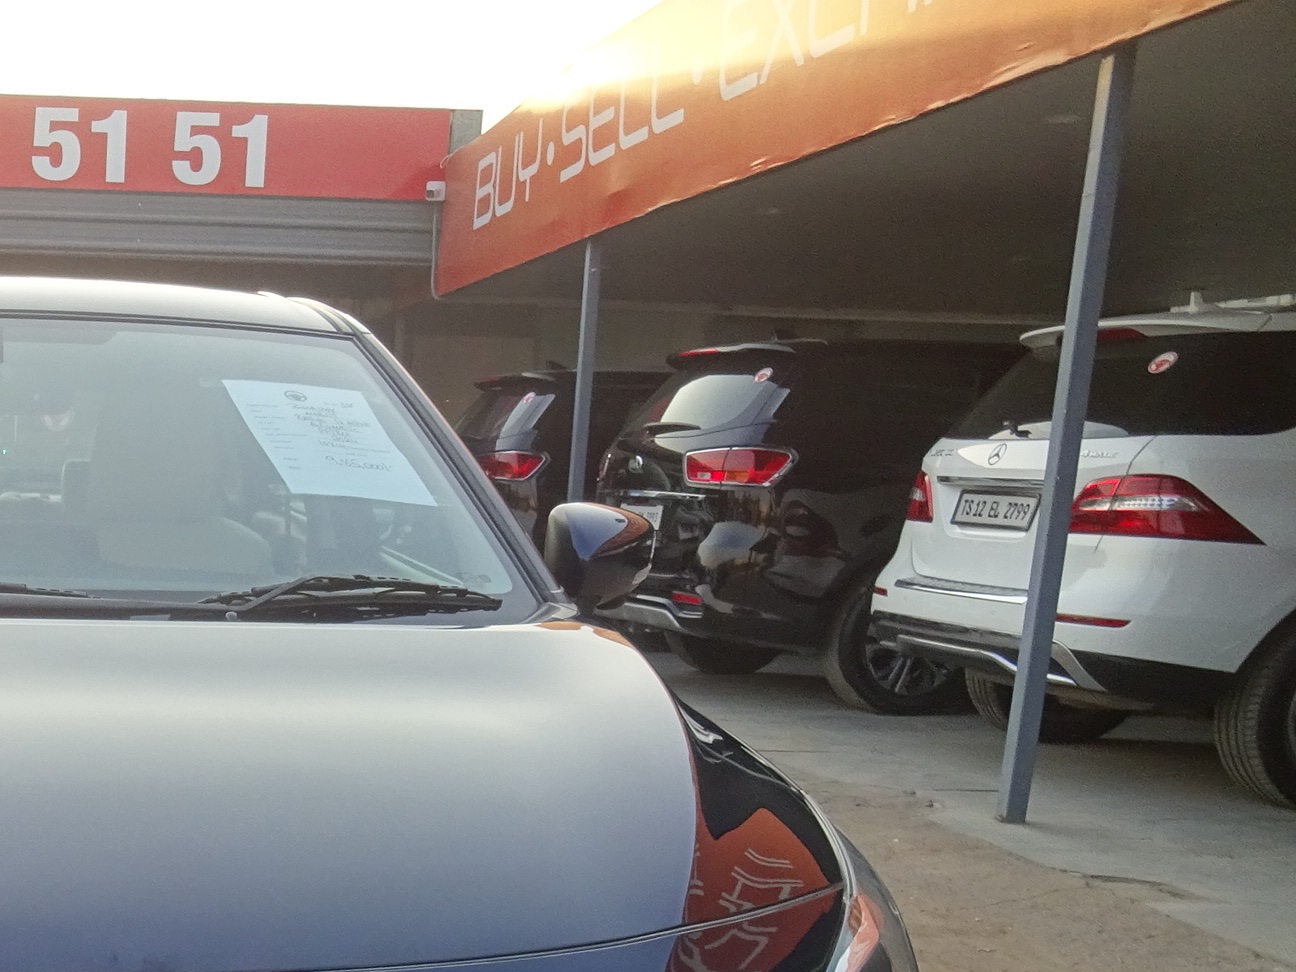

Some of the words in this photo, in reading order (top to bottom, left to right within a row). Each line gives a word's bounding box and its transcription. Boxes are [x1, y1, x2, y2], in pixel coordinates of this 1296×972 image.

[31, 106, 128, 184] 51
[171, 110, 270, 188] 51
[1003, 501, 1031, 522] 2799
